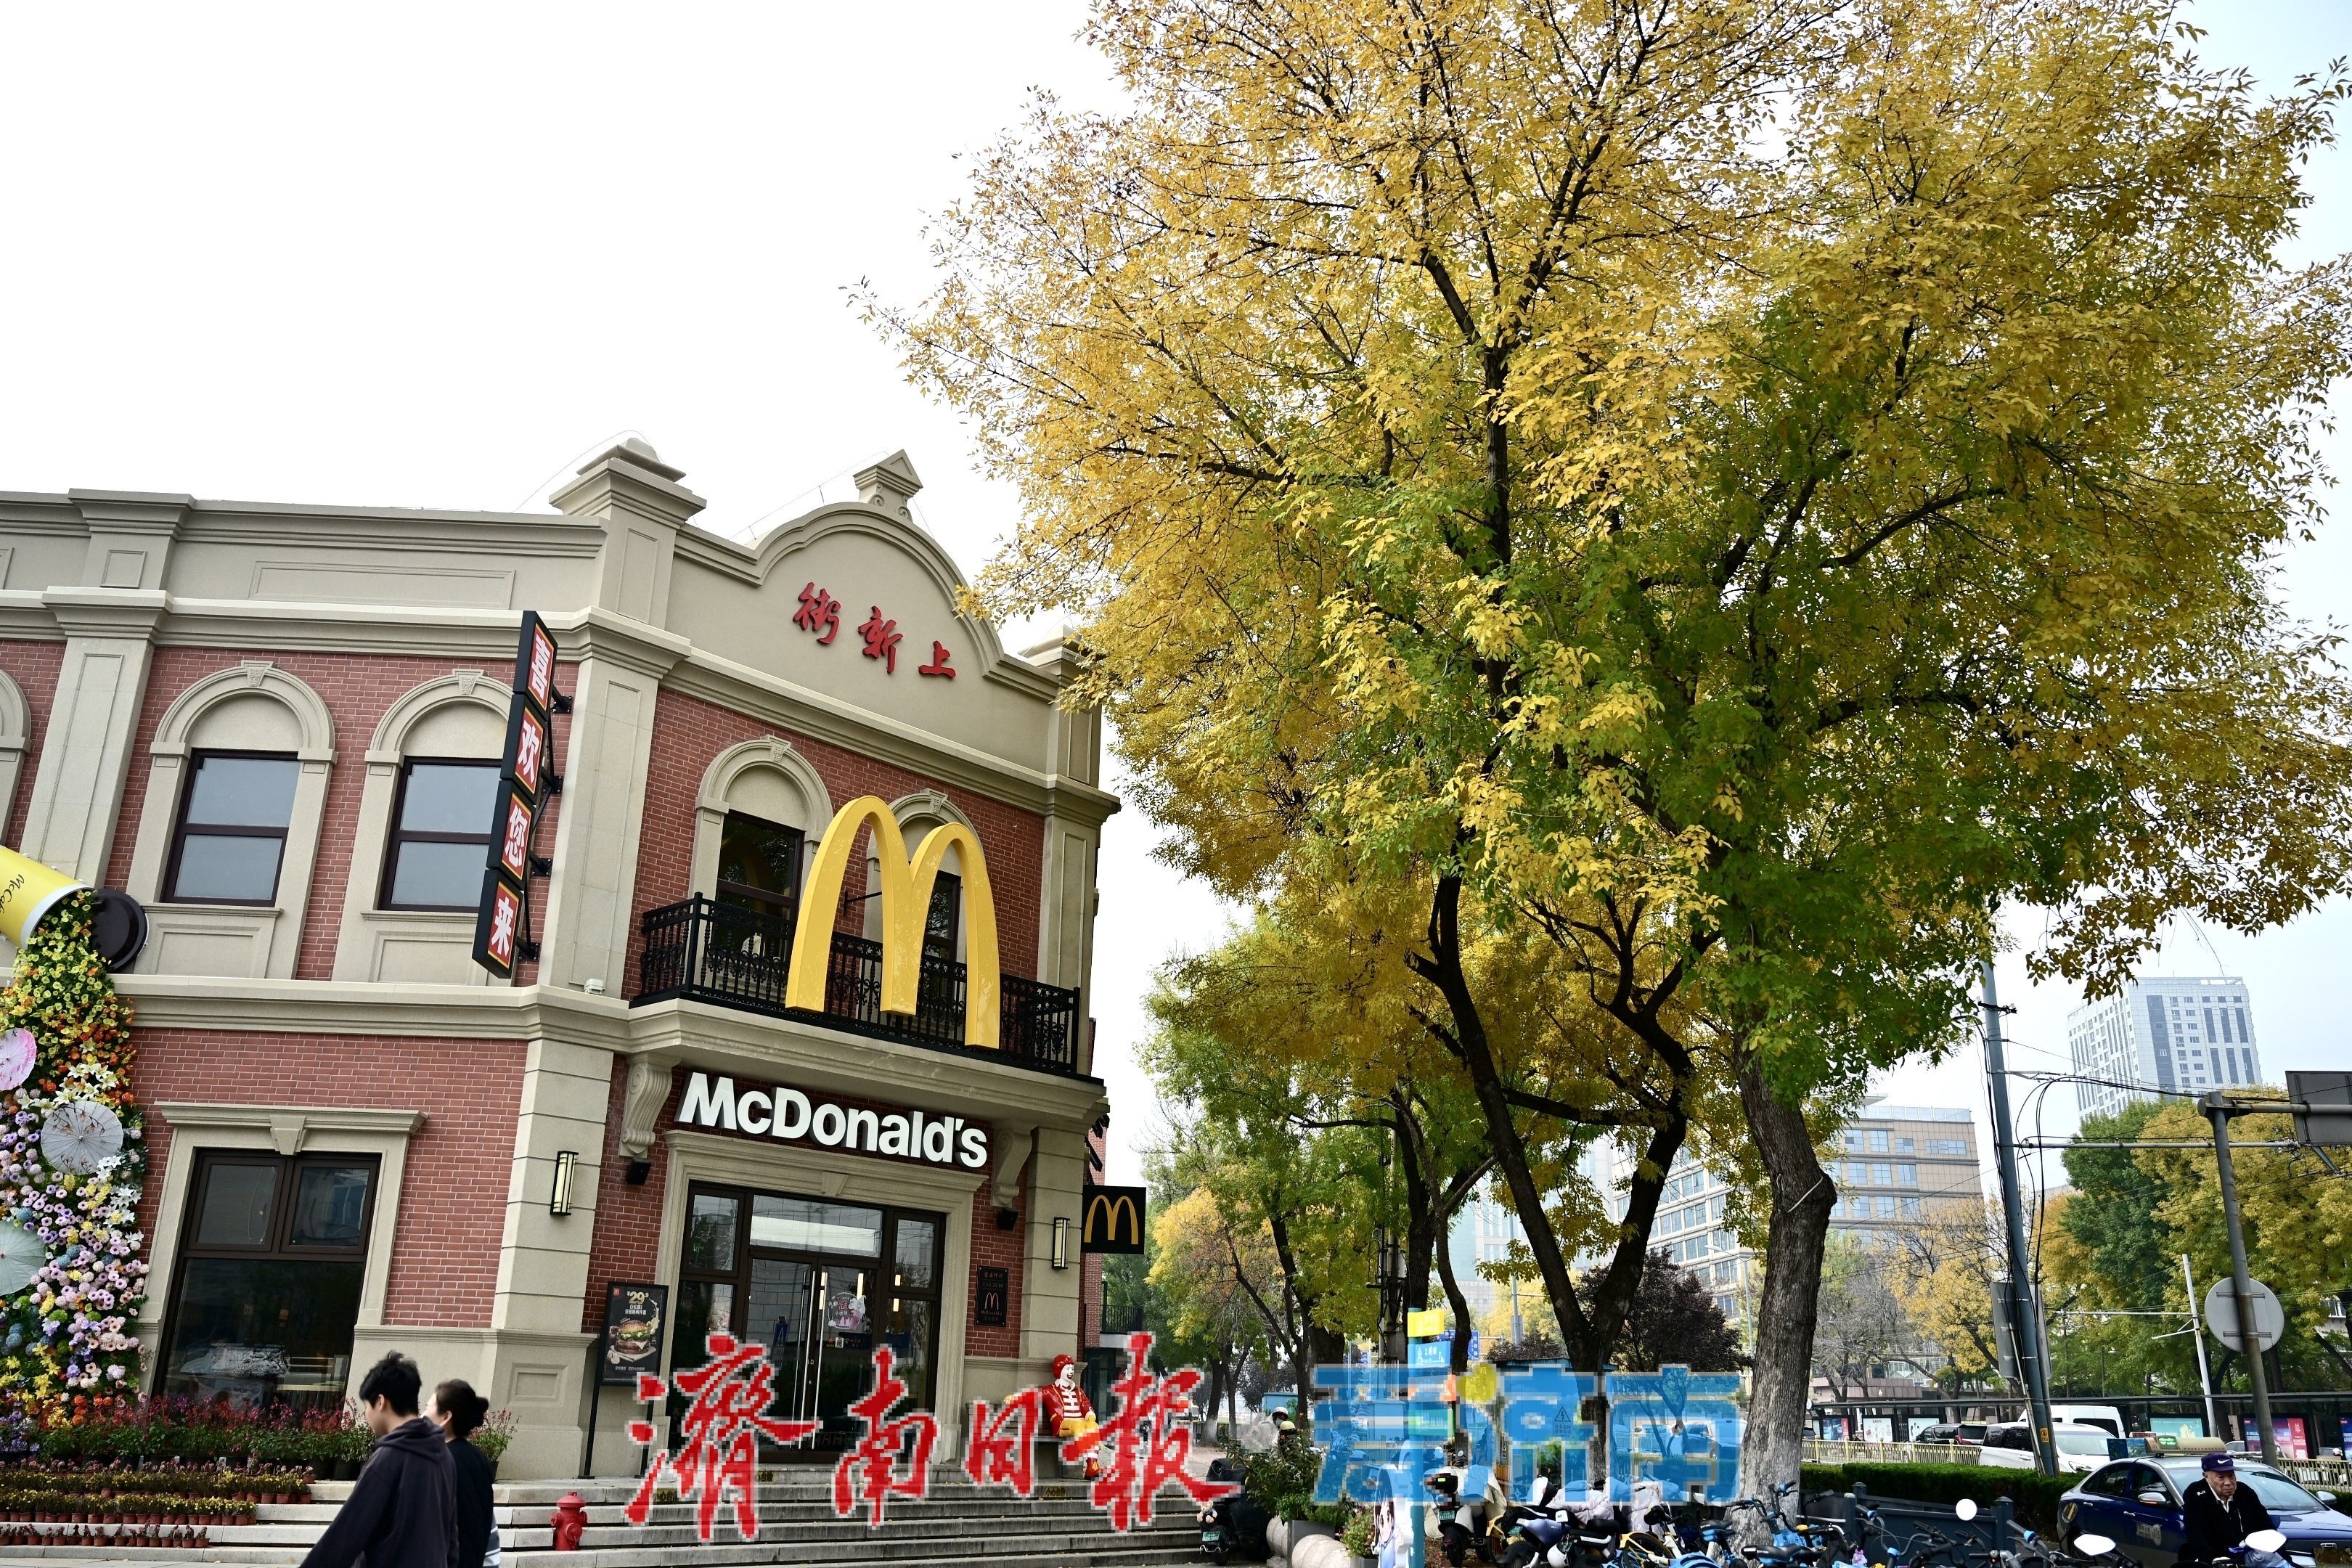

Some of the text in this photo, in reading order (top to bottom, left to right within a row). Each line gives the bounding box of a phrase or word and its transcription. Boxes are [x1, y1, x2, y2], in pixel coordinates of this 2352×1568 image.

[491, 633, 550, 957] 喜欢您来
[0, 874, 25, 914] McCaf
[675, 1072, 987, 1168] McDonald's
